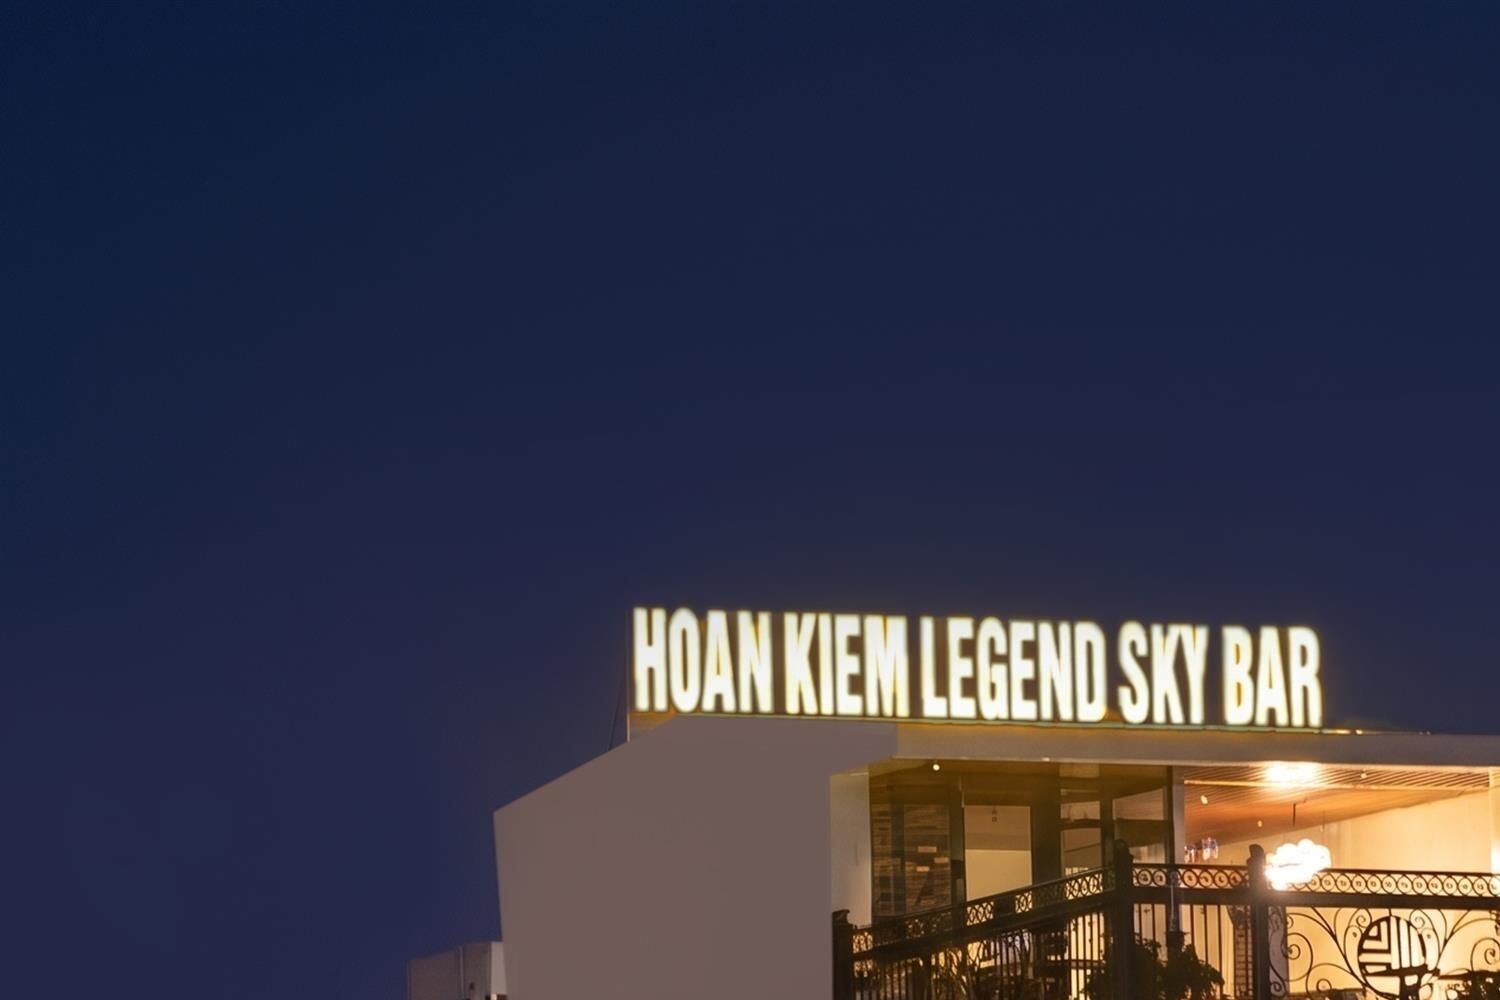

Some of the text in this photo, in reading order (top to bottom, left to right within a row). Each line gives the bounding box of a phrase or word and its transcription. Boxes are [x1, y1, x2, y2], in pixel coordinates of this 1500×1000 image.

[633, 608, 1323, 727] HOAN KIEM LEGEND SKY BAR
